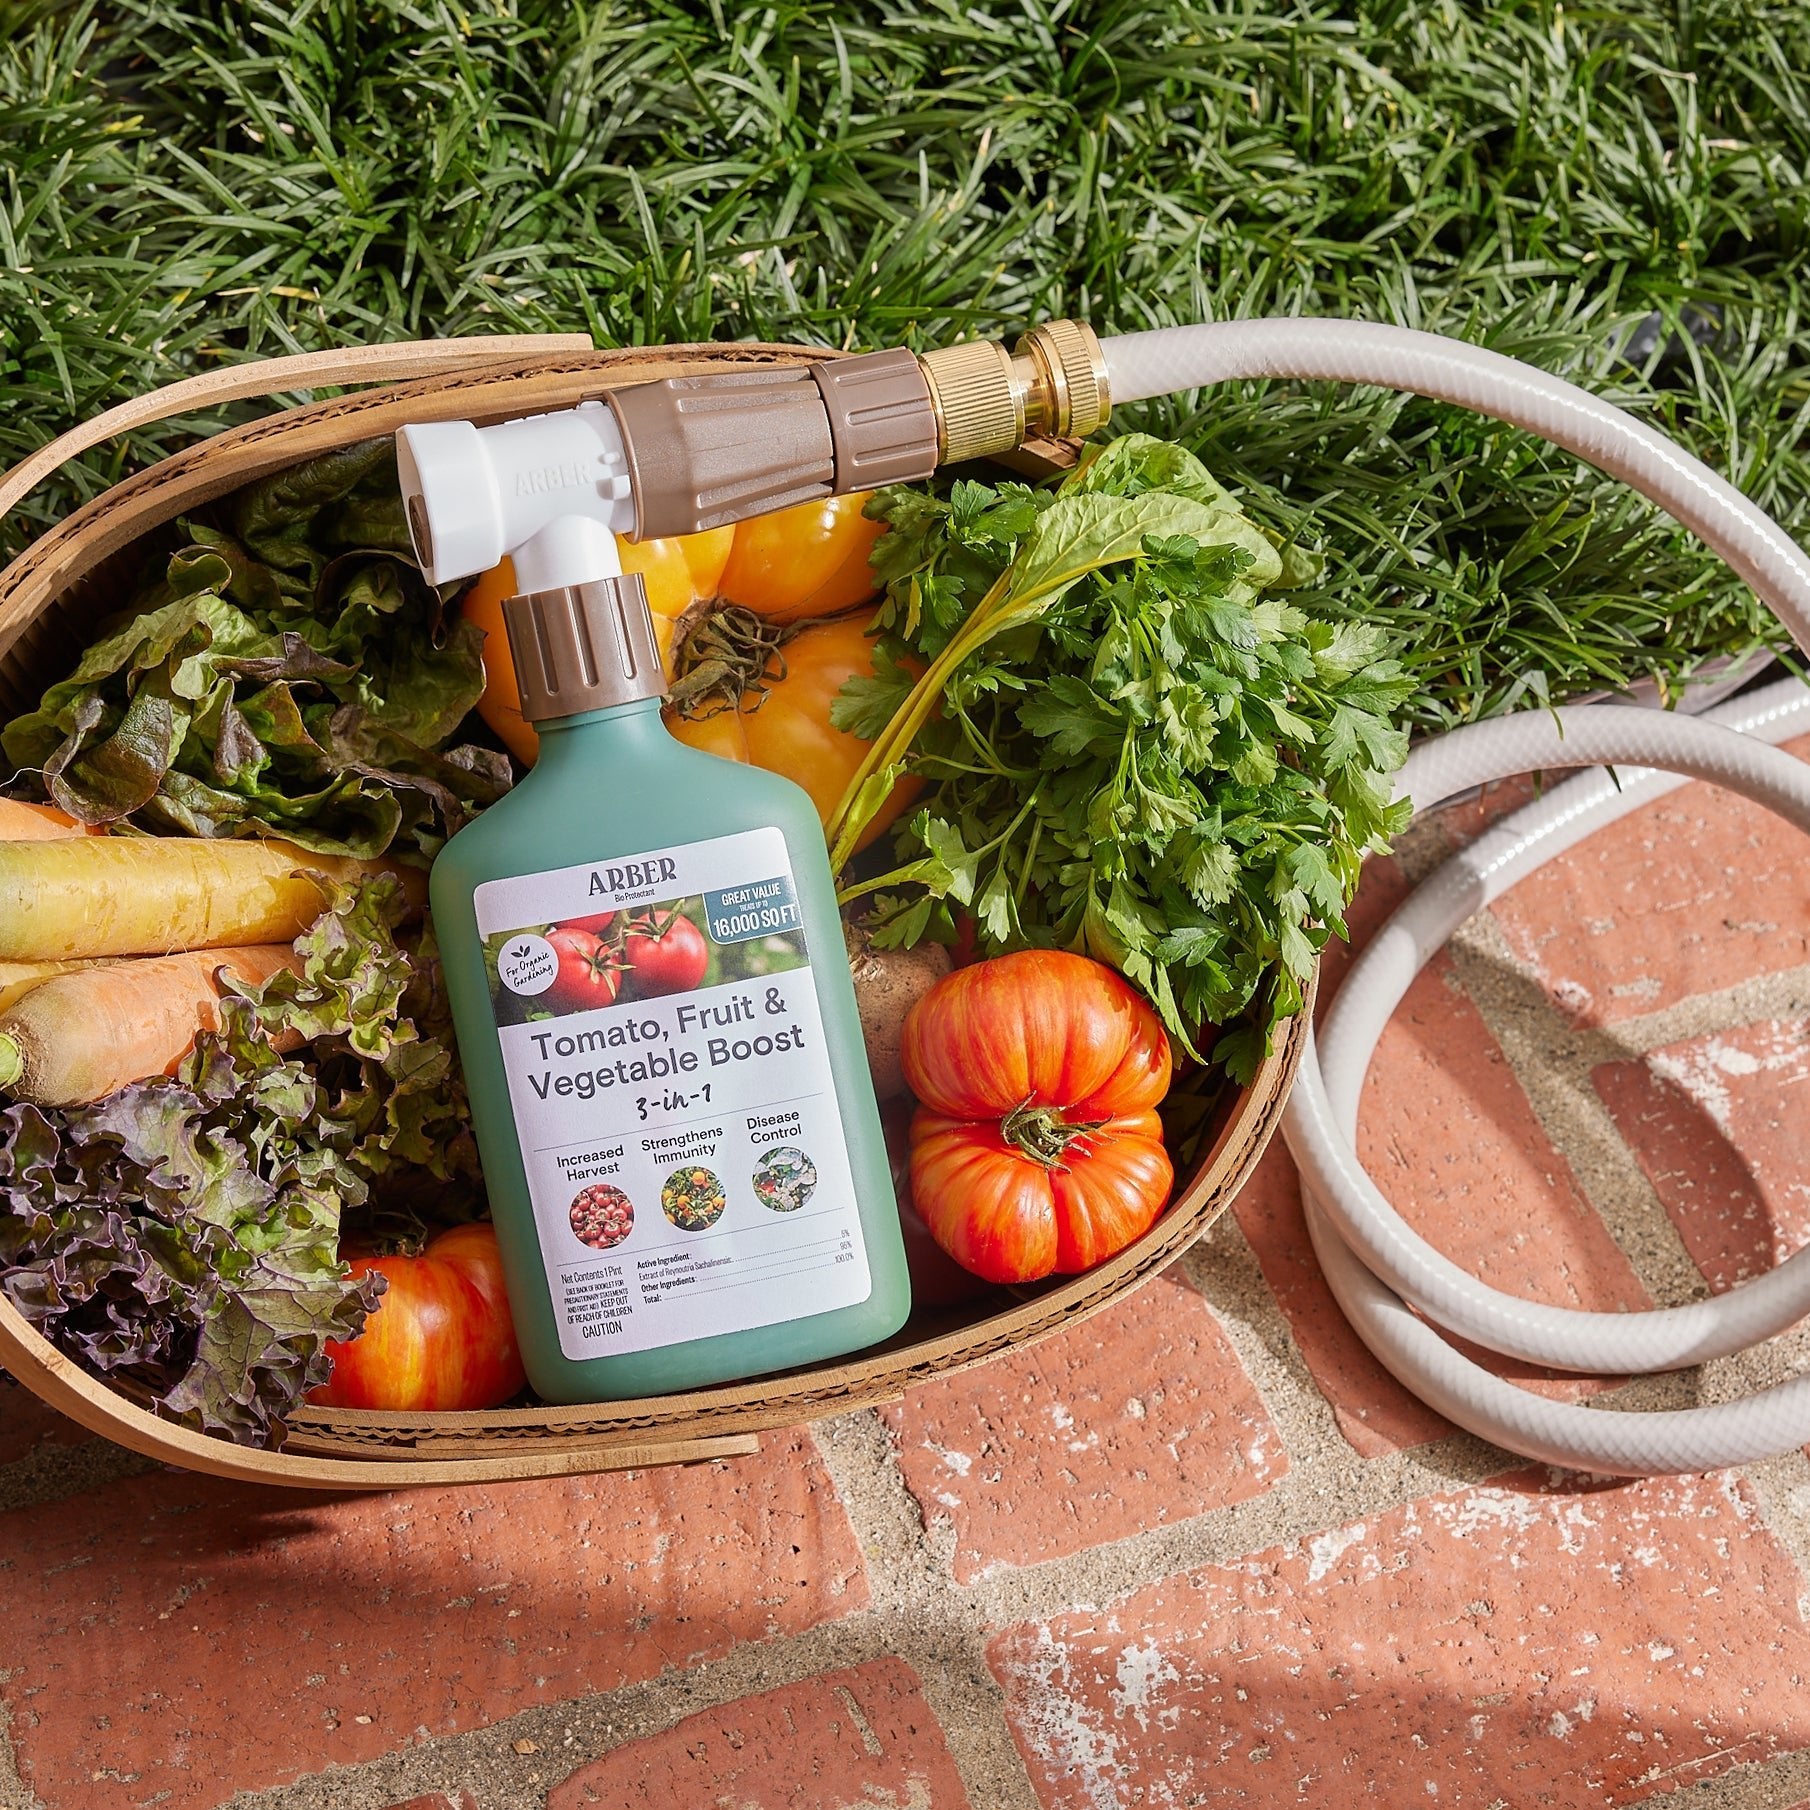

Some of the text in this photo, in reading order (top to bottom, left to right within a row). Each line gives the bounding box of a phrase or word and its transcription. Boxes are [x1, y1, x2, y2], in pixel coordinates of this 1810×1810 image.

[515, 462, 593, 496] ARBER
[589, 858, 676, 896] ARBER
[615, 888, 655, 902] Bio Protectant
[721, 883, 781, 906] GREAT VALUE
[714, 904, 796, 938] 16,000 SQ FT
[506, 952, 549, 977] For Organic
[514, 965, 553, 987] Gardening
[531, 987, 787, 1061] Tomato, Fruit &
[528, 1024, 805, 1101] Vegetable Boost
[635, 1084, 713, 1121] 3-in-1
[747, 1110, 800, 1130] Disease
[641, 1126, 723, 1152] Strengthens
[750, 1124, 802, 1145] Control
[557, 1145, 624, 1168] Increased
[653, 1143, 716, 1165] Immunity
[566, 1162, 620, 1182] Harvest
[637, 1253, 692, 1269] Active Ingredient:
[561, 1274, 574, 1284] Net
[574, 1270, 604, 1283] Contents
[608, 1266, 622, 1276] Pint
[639, 1272, 658, 1281] Extract
[659, 1269, 665, 1277] of
[665, 1265, 695, 1277] Reynoutria
[595, 1281, 614, 1290] BOOKLET
[641, 1284, 658, 1292] Other
[659, 1276, 697, 1289] Ingredients:
[564, 1288, 628, 1304] PRECAUTIONARY STATEMENTS
[600, 1298, 615, 1308] KEEP
[616, 1296, 628, 1305] OUT
[643, 1294, 662, 1304] Total:
[568, 1306, 632, 1324] OF REACH OF CHILDREN
[582, 1321, 622, 1338] CAUTION
